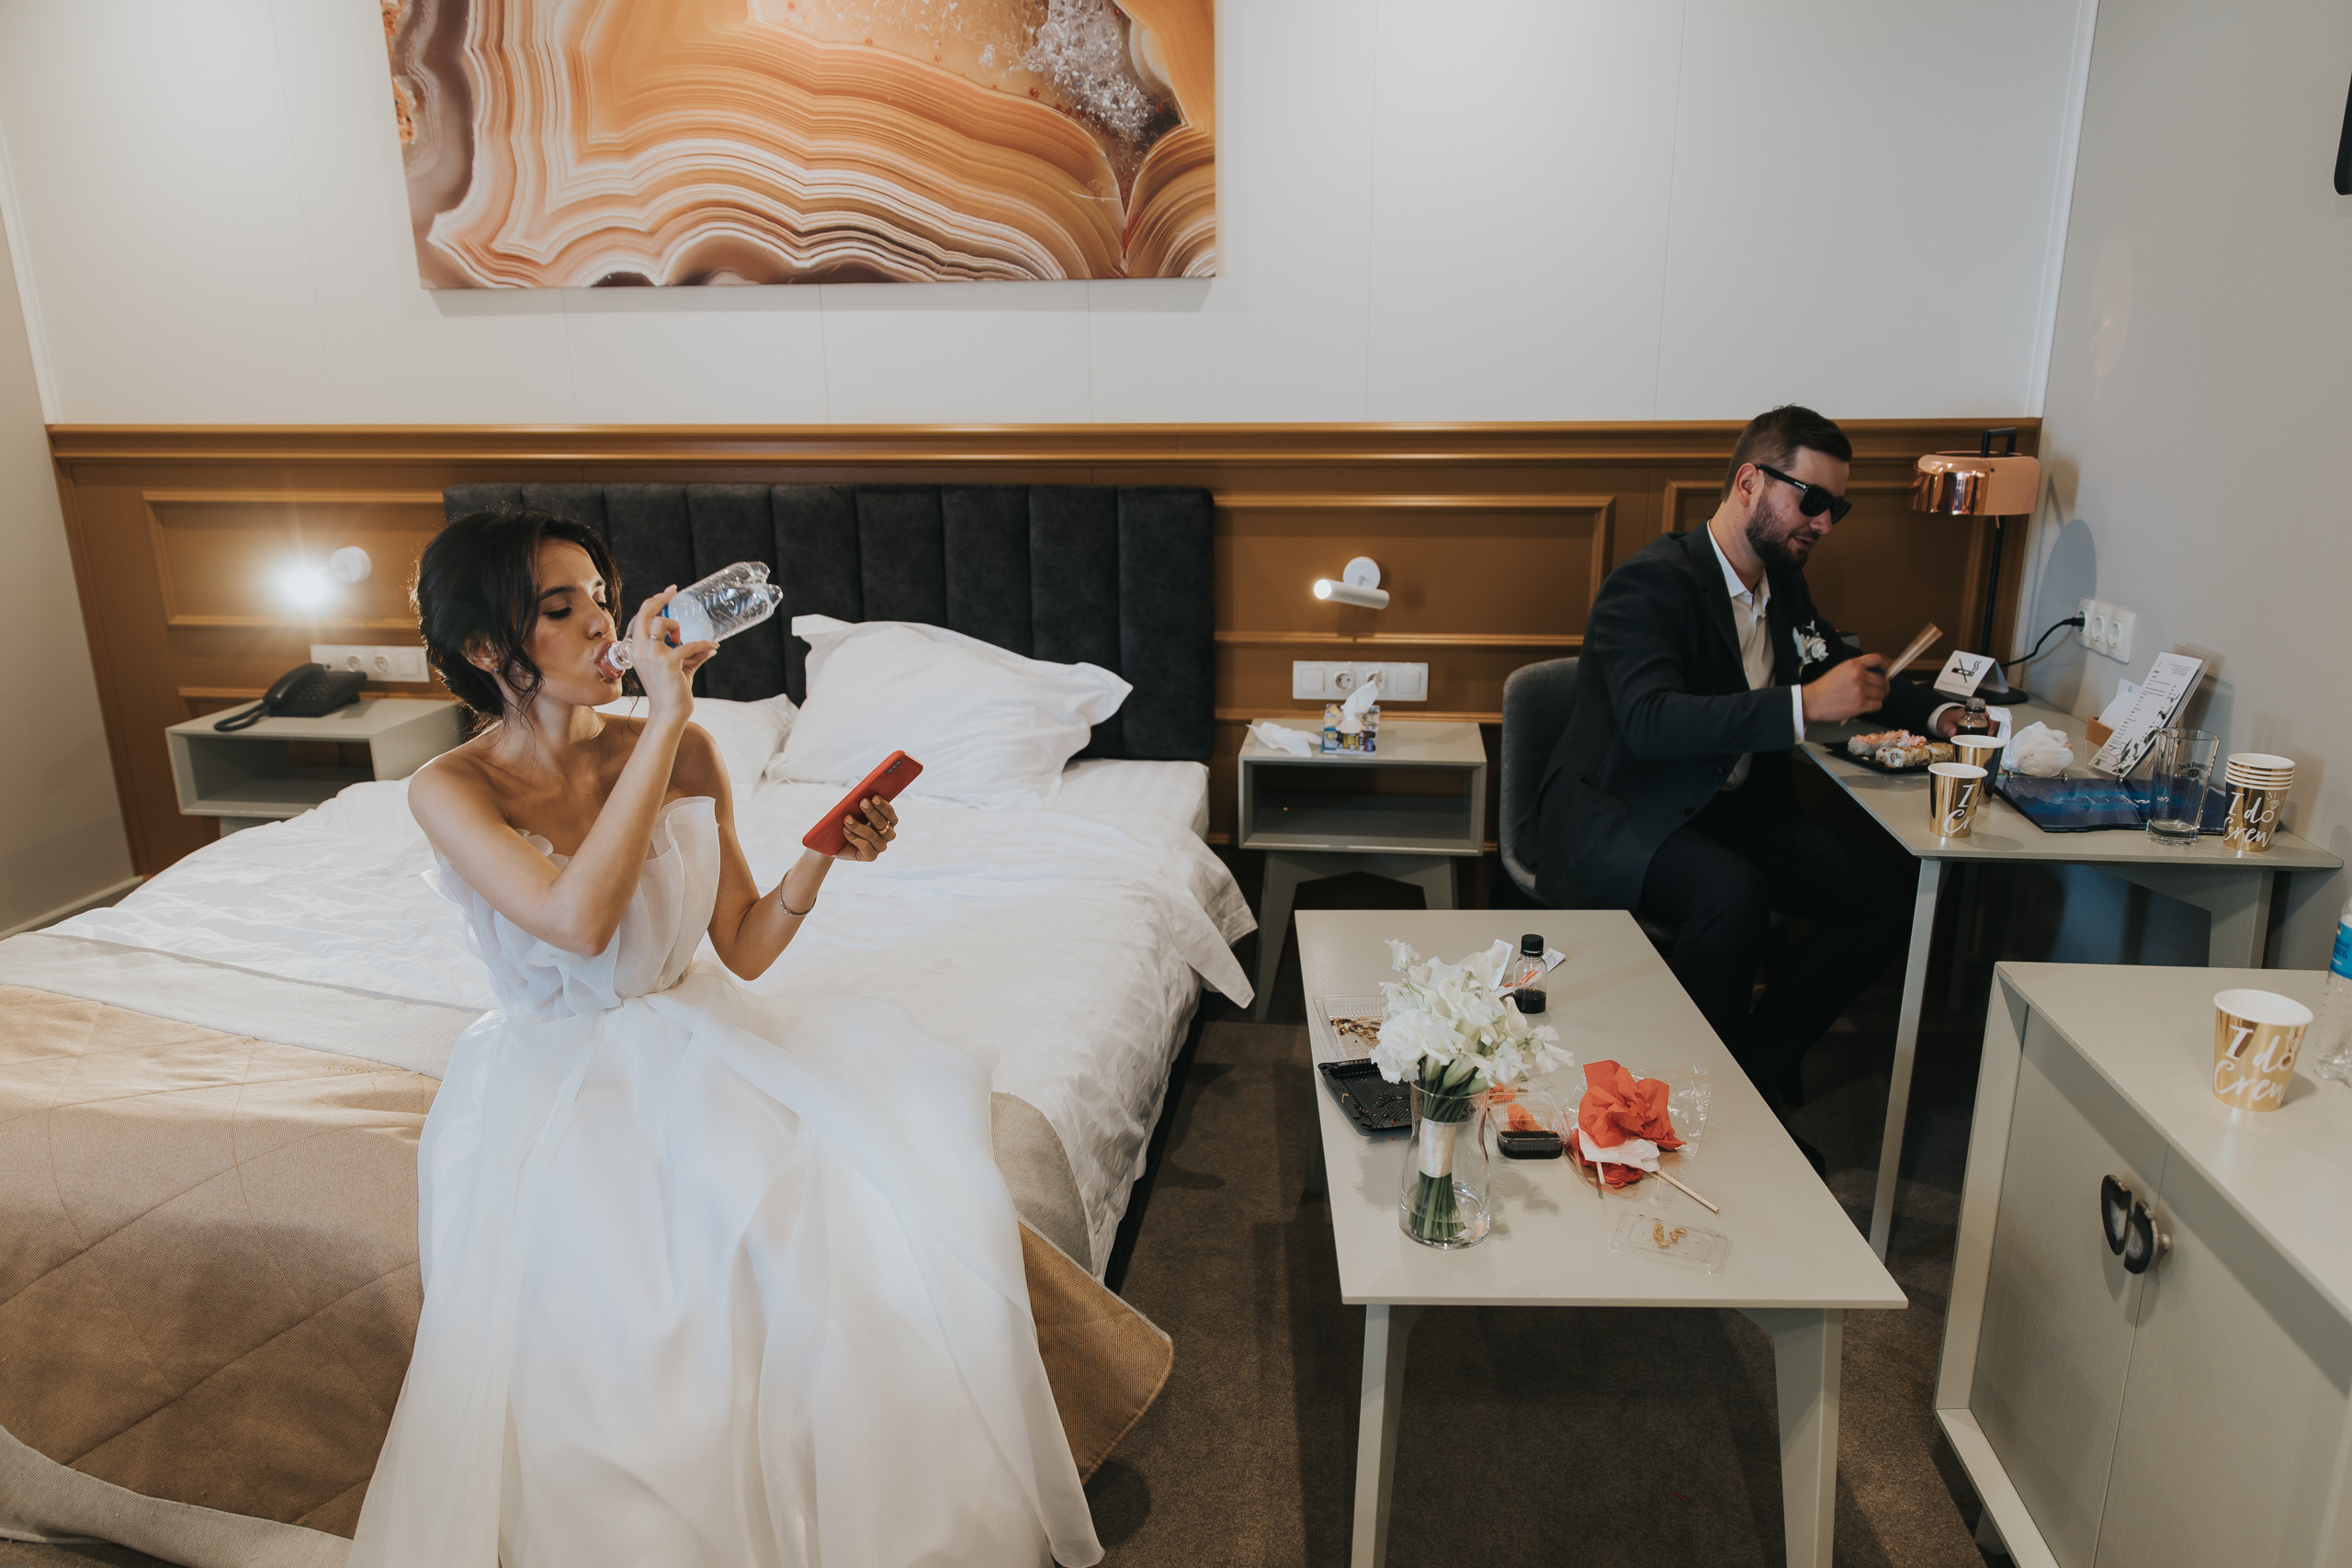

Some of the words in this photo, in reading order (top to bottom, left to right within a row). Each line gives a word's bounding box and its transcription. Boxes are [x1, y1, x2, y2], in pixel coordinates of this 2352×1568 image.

[1957, 784, 1977, 807] I
[2227, 791, 2245, 816] I
[2243, 796, 2275, 824] do
[2223, 816, 2277, 848] Crew
[2225, 1024, 2254, 1060] I
[2252, 1034, 2295, 1073] do
